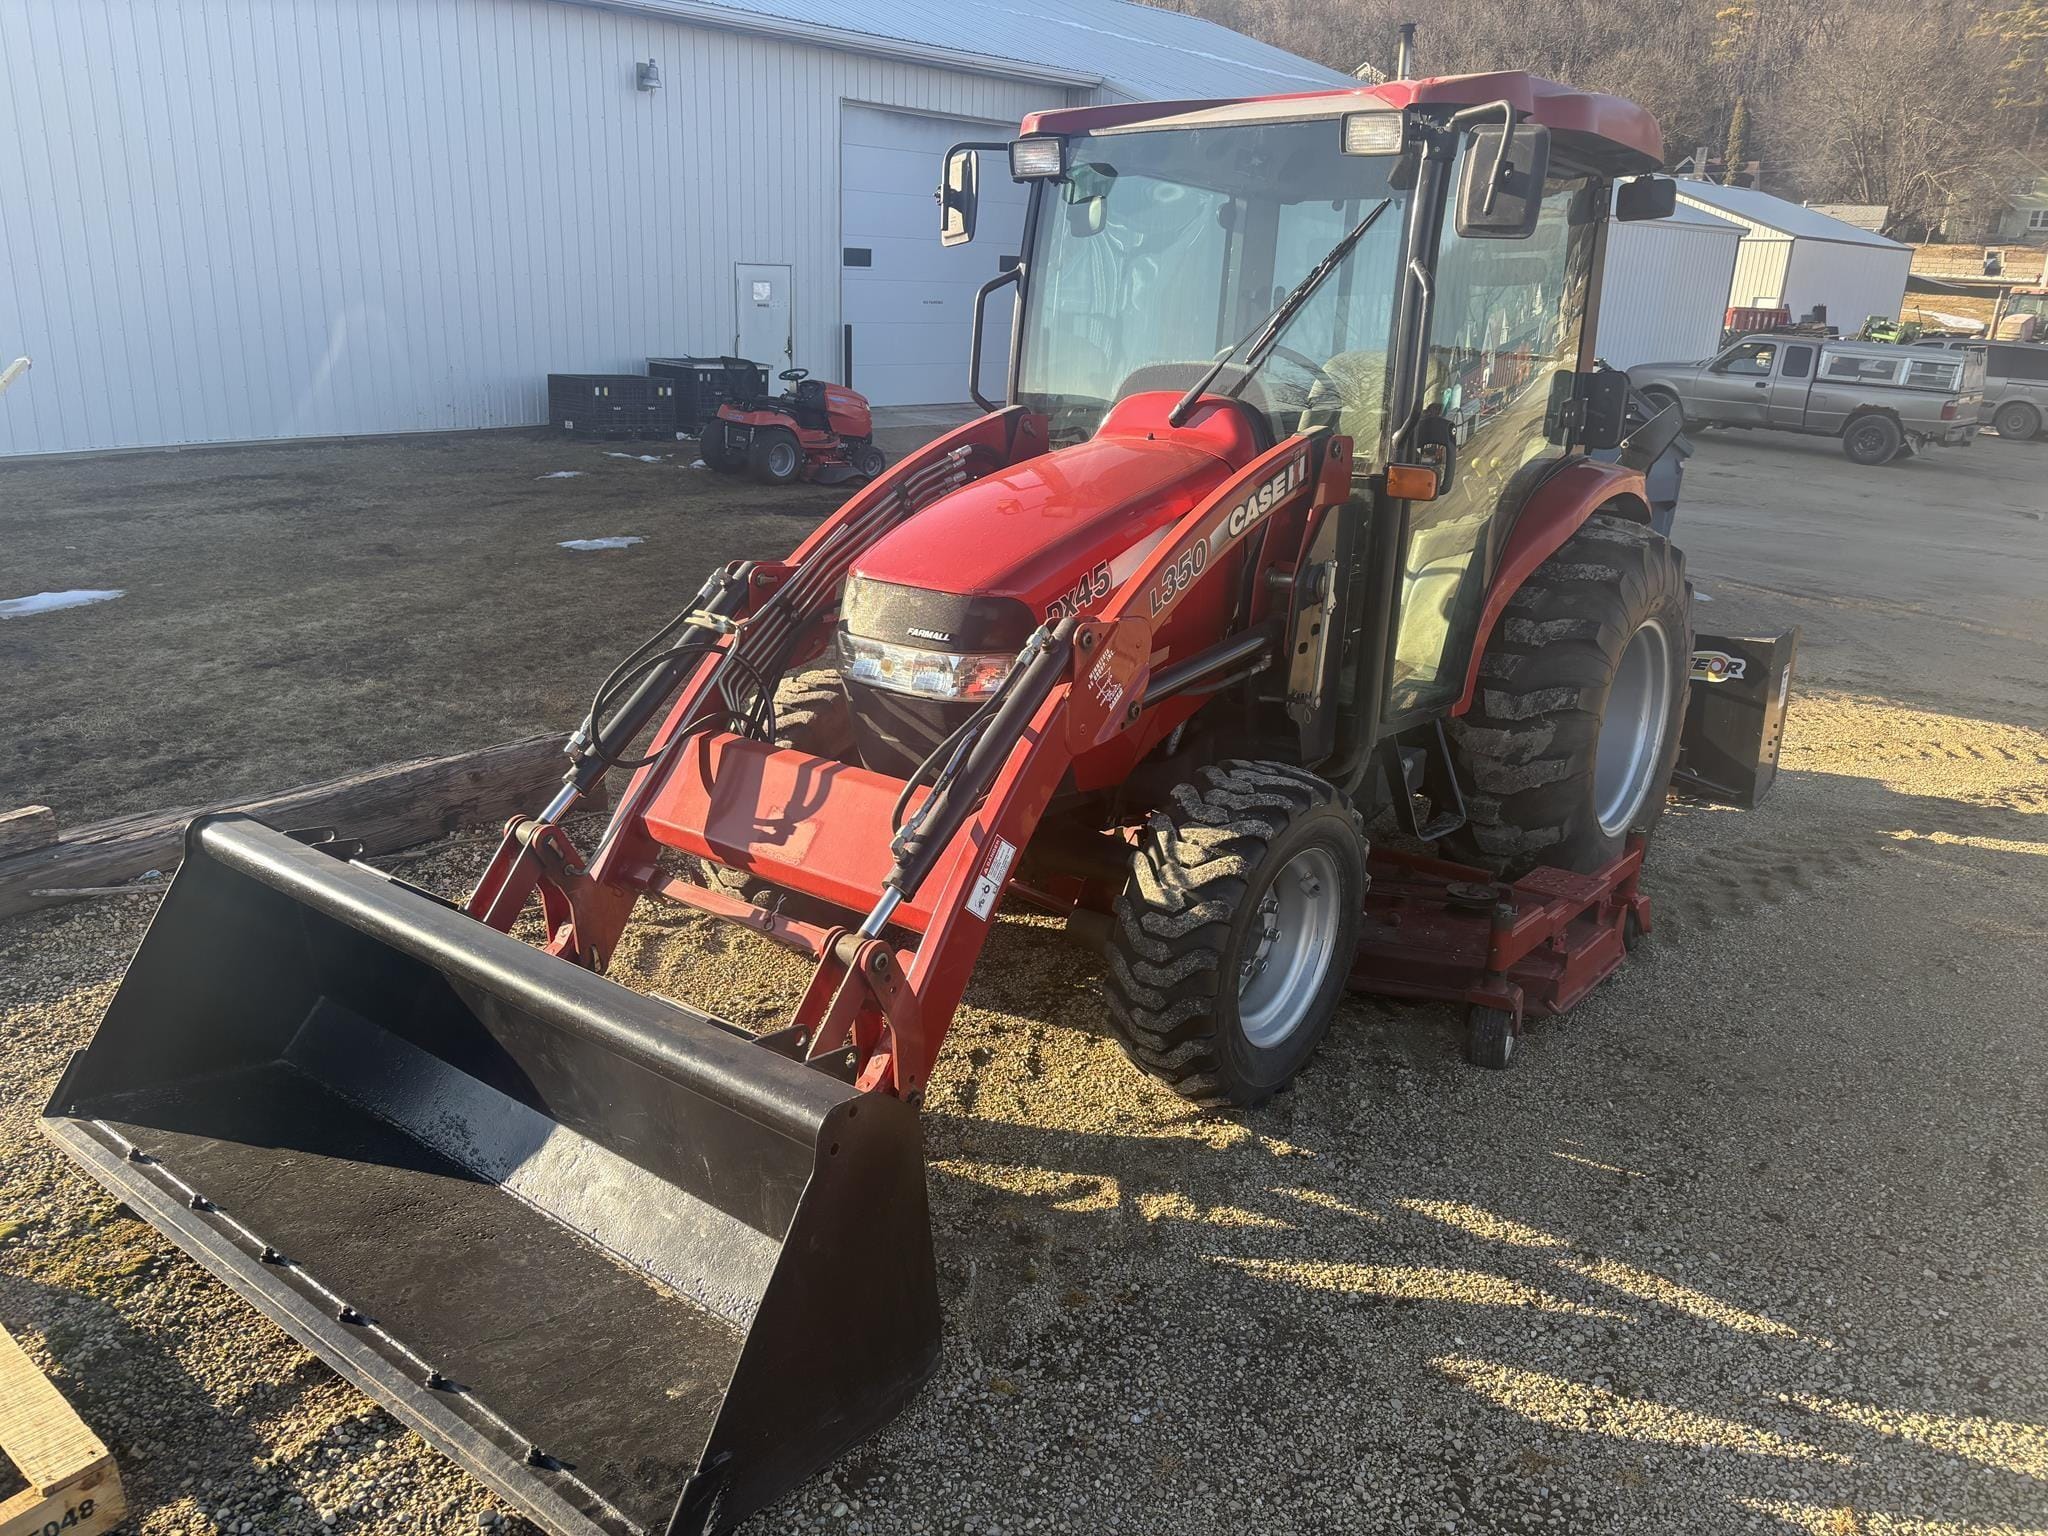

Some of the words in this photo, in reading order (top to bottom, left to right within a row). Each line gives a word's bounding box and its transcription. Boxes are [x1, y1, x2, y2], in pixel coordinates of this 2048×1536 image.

[1229, 472, 1286, 538] CASE
[1045, 559, 1112, 618] DX45
[1149, 538, 1208, 618] L350
[906, 627, 951, 641] FARMALL
[27, 1498, 95, 1536] 048
